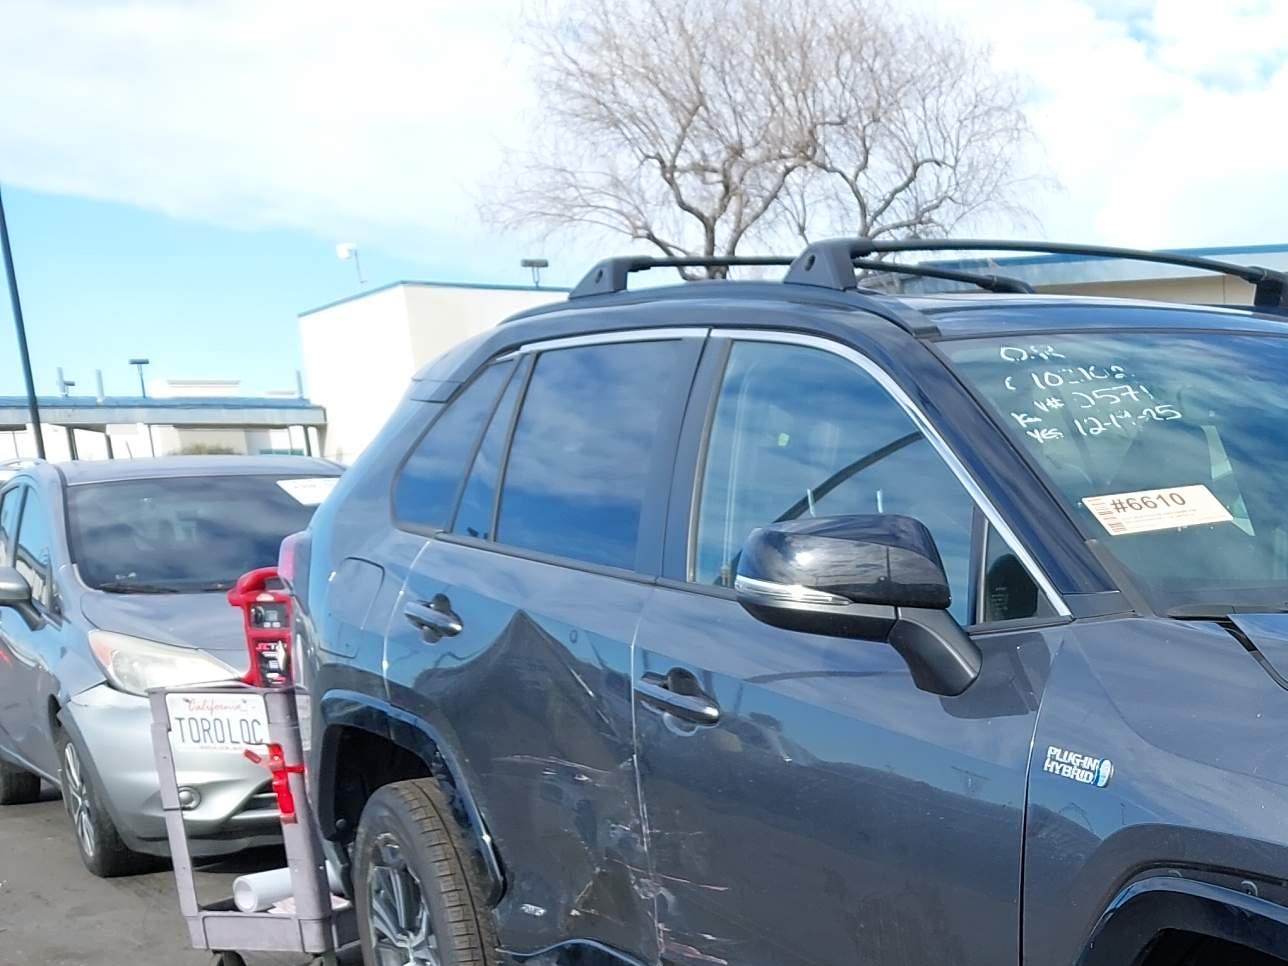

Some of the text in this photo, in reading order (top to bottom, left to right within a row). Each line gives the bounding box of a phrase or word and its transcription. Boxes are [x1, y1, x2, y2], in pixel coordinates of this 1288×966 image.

[1111, 492, 1186, 514] #6610
[189, 697, 241, 716] California
[175, 717, 264, 744] TOROLOC
[1043, 758, 1094, 784] HYBRID
